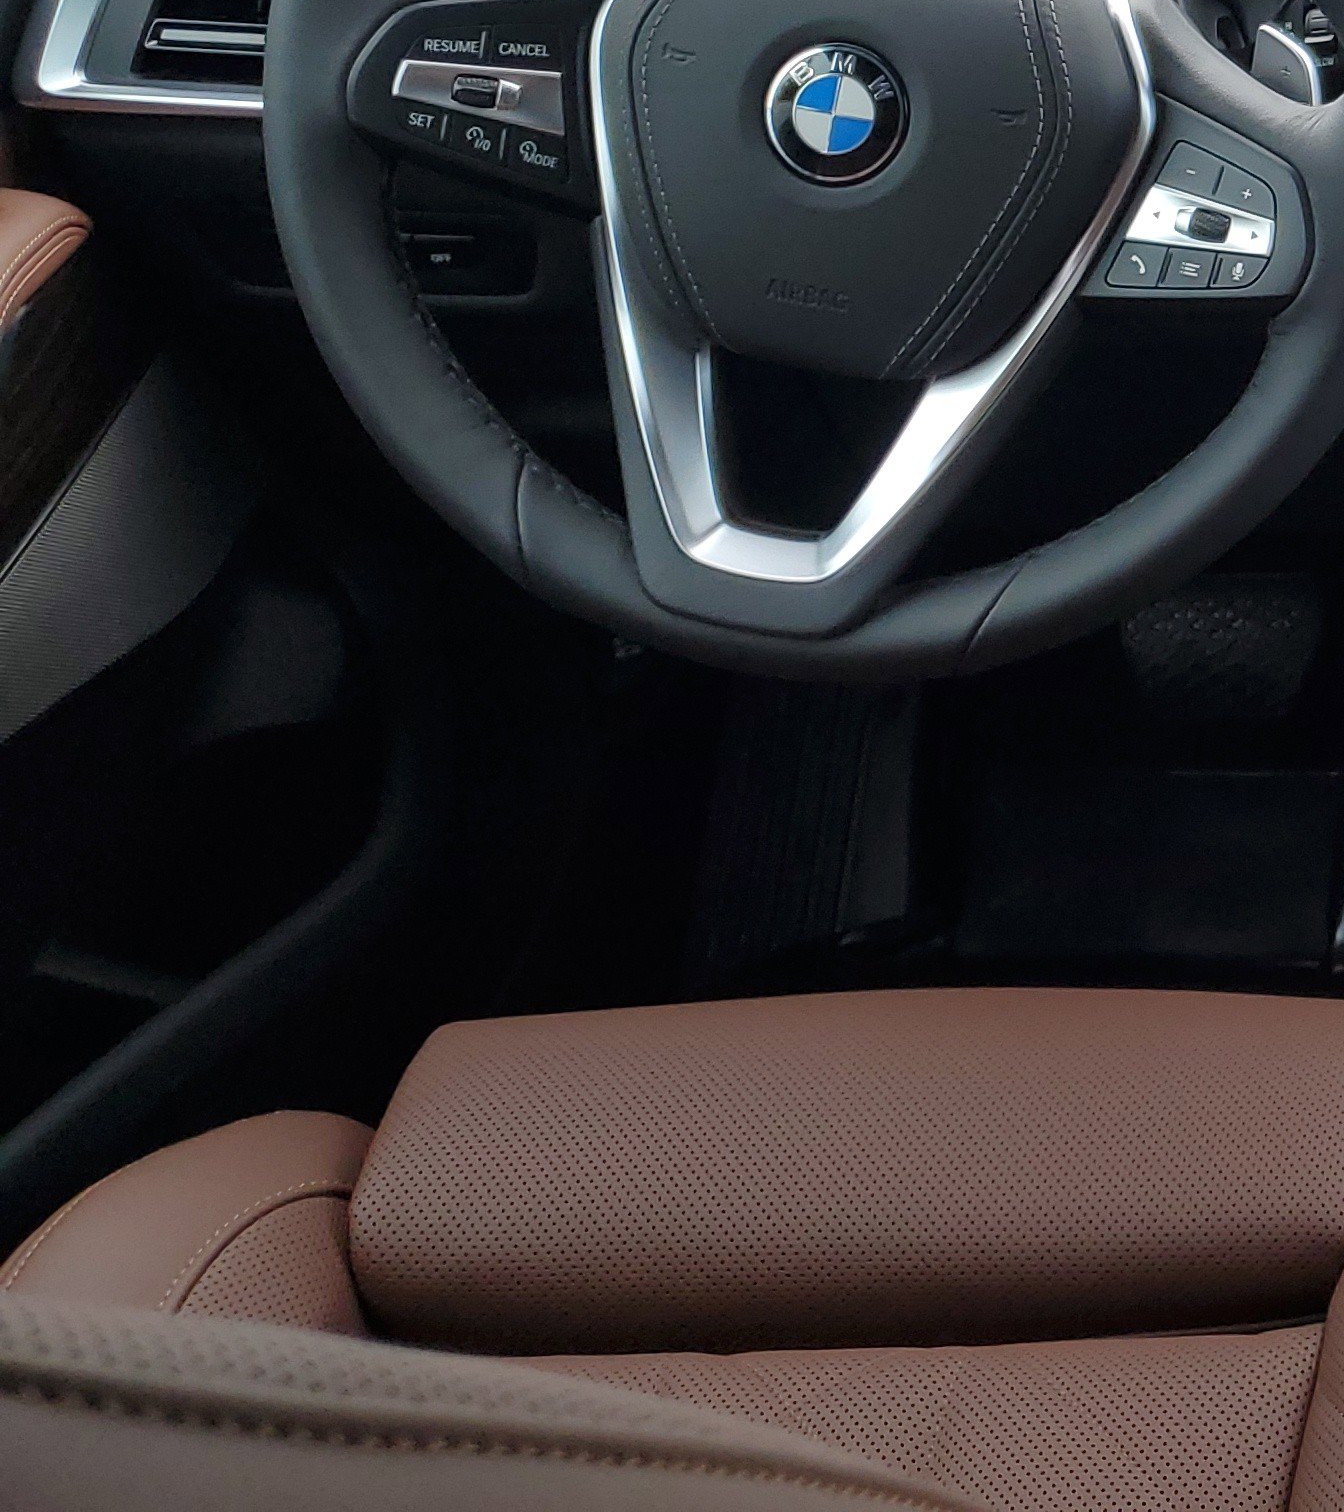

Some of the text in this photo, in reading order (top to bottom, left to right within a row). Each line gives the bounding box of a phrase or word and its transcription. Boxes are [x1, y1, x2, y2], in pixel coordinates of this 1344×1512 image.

[423, 39, 550, 57] RESUME CANCEL
[790, 51, 895, 101] BMW
[408, 112, 436, 129] SET
[523, 153, 559, 168] MODE
